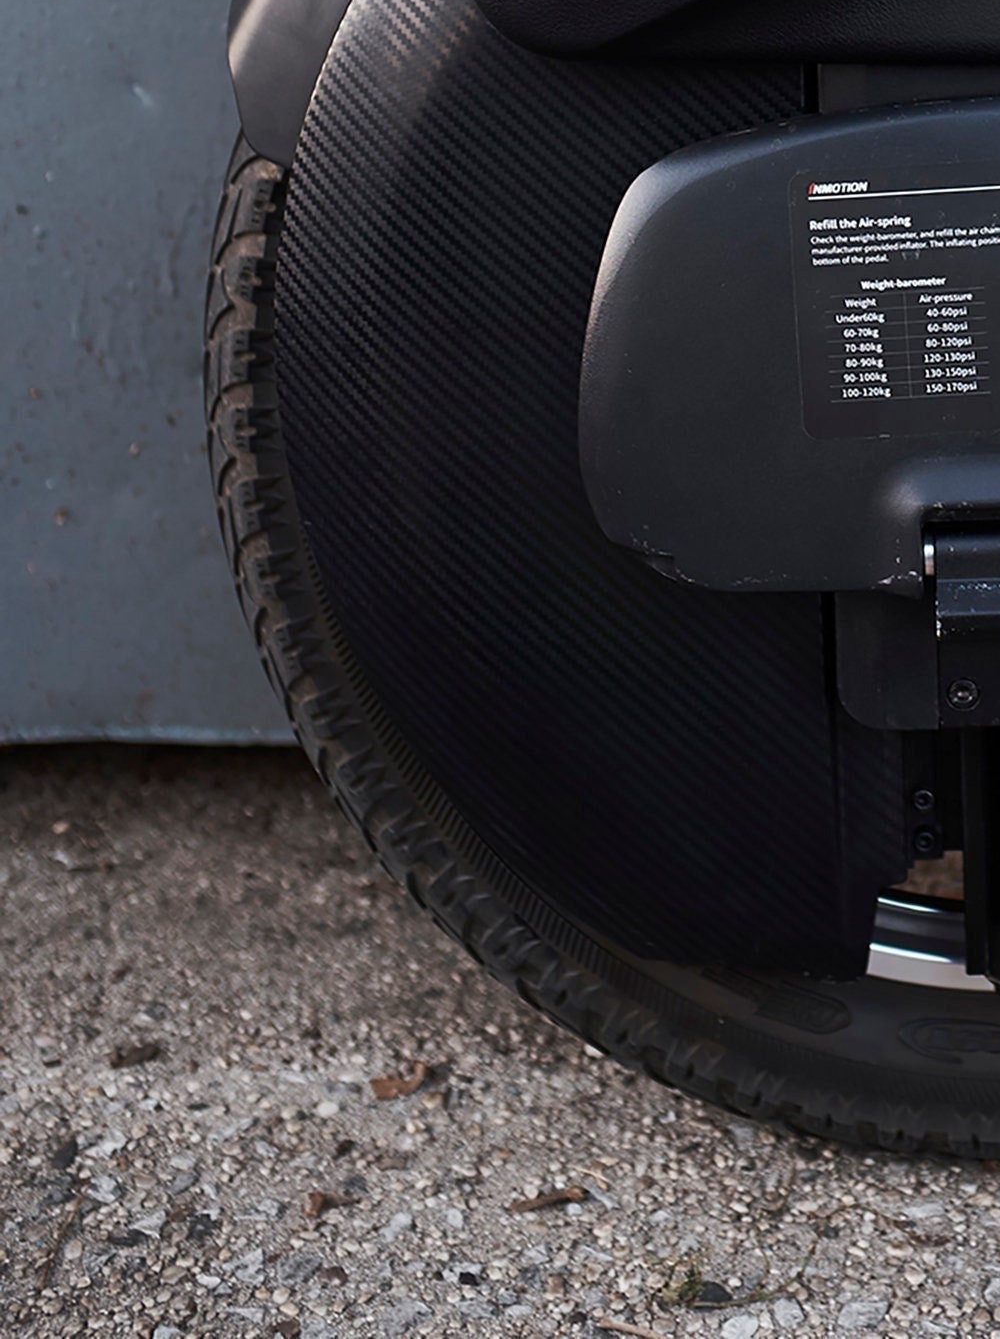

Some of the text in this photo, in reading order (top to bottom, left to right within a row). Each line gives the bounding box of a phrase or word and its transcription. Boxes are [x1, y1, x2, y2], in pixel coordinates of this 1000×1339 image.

[808, 182, 868, 195] INMOTION
[810, 216, 911, 230] Refill the Air-spring
[811, 236, 833, 244] Check
[920, 230, 934, 238] and
[969, 227, 978, 235] air
[864, 243, 898, 252] provided
[946, 239, 976, 247] inflating
[842, 256, 849, 264] of
[851, 255, 863, 263] the
[865, 254, 888, 264] pedal.
[861, 277, 946, 291] Weight-barometer
[845, 293, 973, 308] Weight Air-pressure
[836, 307, 967, 323] Under60kg 40-60psi
[844, 322, 968, 338] 60-70kg 60-80psi
[844, 337, 972, 353] 70-80kg 80-120psi
[846, 352, 975, 368] 80-90kg 120-130psi
[843, 367, 976, 383] 90-100kg 130-150psi
[843, 382, 977, 398] 100-120kg 150-170psi
